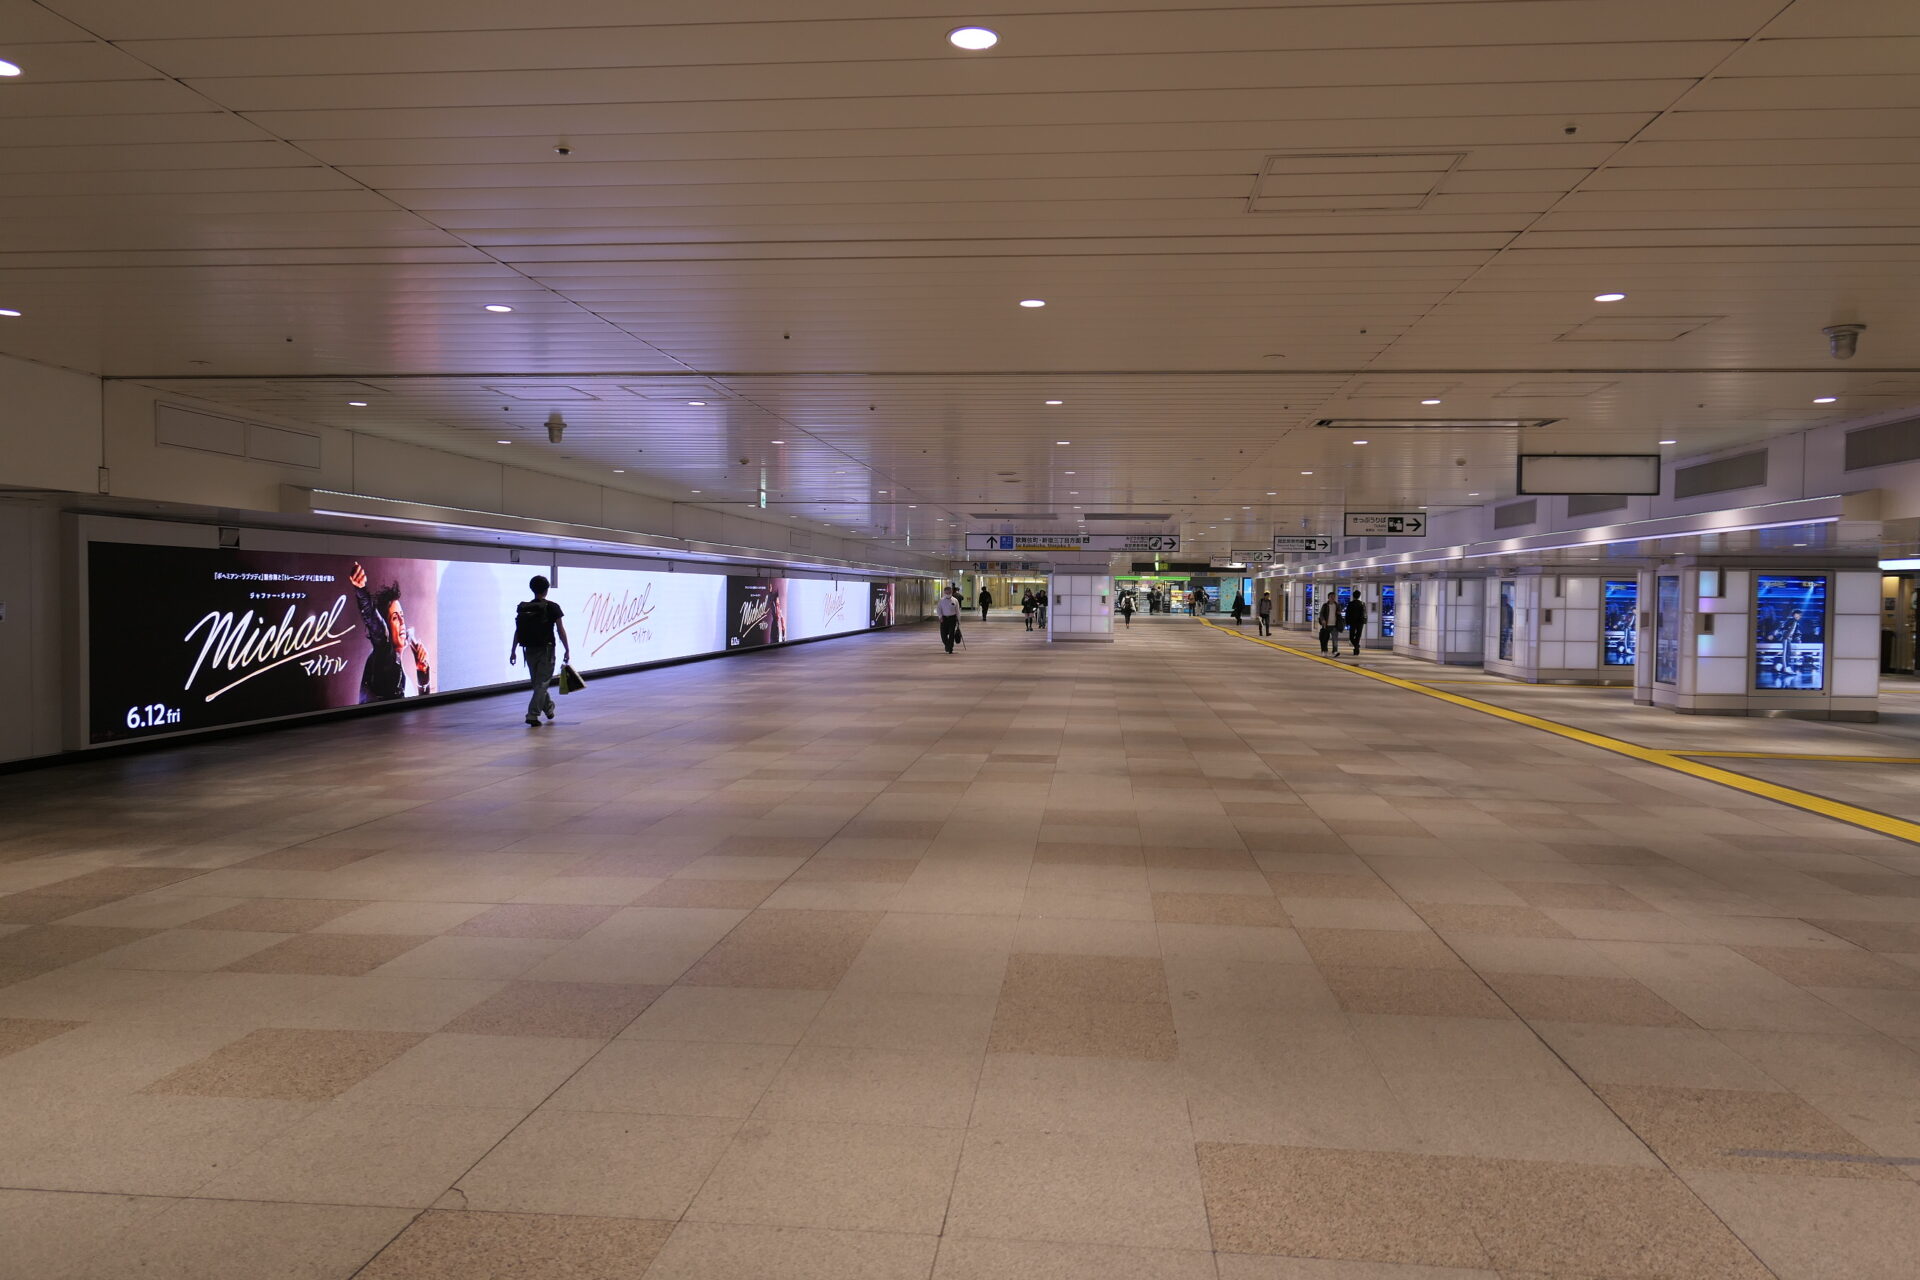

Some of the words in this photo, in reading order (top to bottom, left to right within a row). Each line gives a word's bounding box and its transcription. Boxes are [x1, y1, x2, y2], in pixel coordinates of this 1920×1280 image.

[184, 595, 356, 690] Michael
[583, 582, 655, 647] Michael
[299, 653, 348, 677] マイケル
